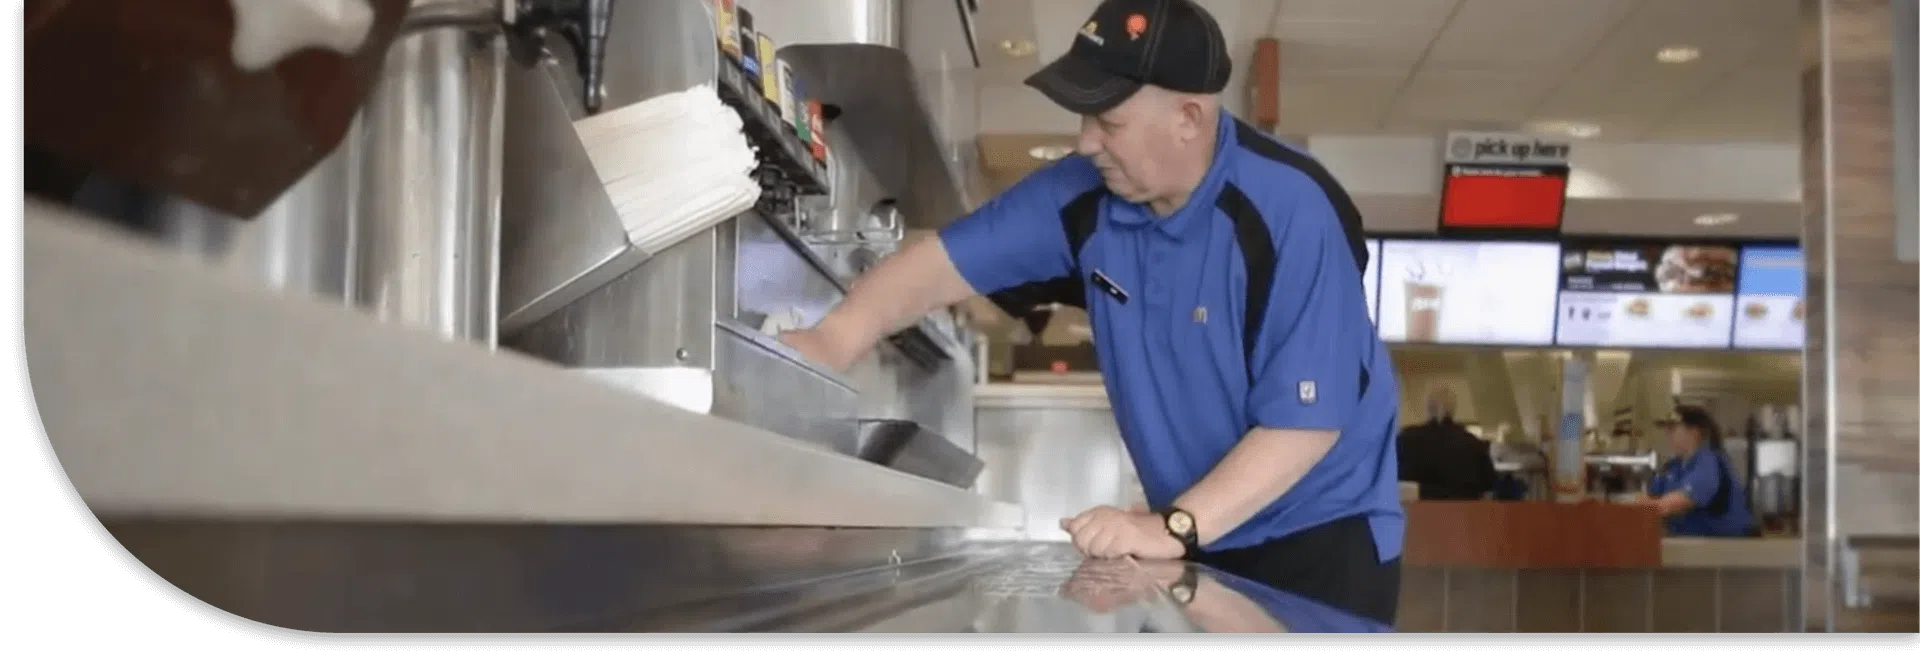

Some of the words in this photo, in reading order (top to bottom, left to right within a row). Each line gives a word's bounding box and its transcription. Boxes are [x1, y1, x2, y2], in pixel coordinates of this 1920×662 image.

[1474, 138, 1507, 159] pick
[1511, 143, 1531, 161] up
[1534, 138, 1570, 158] here
